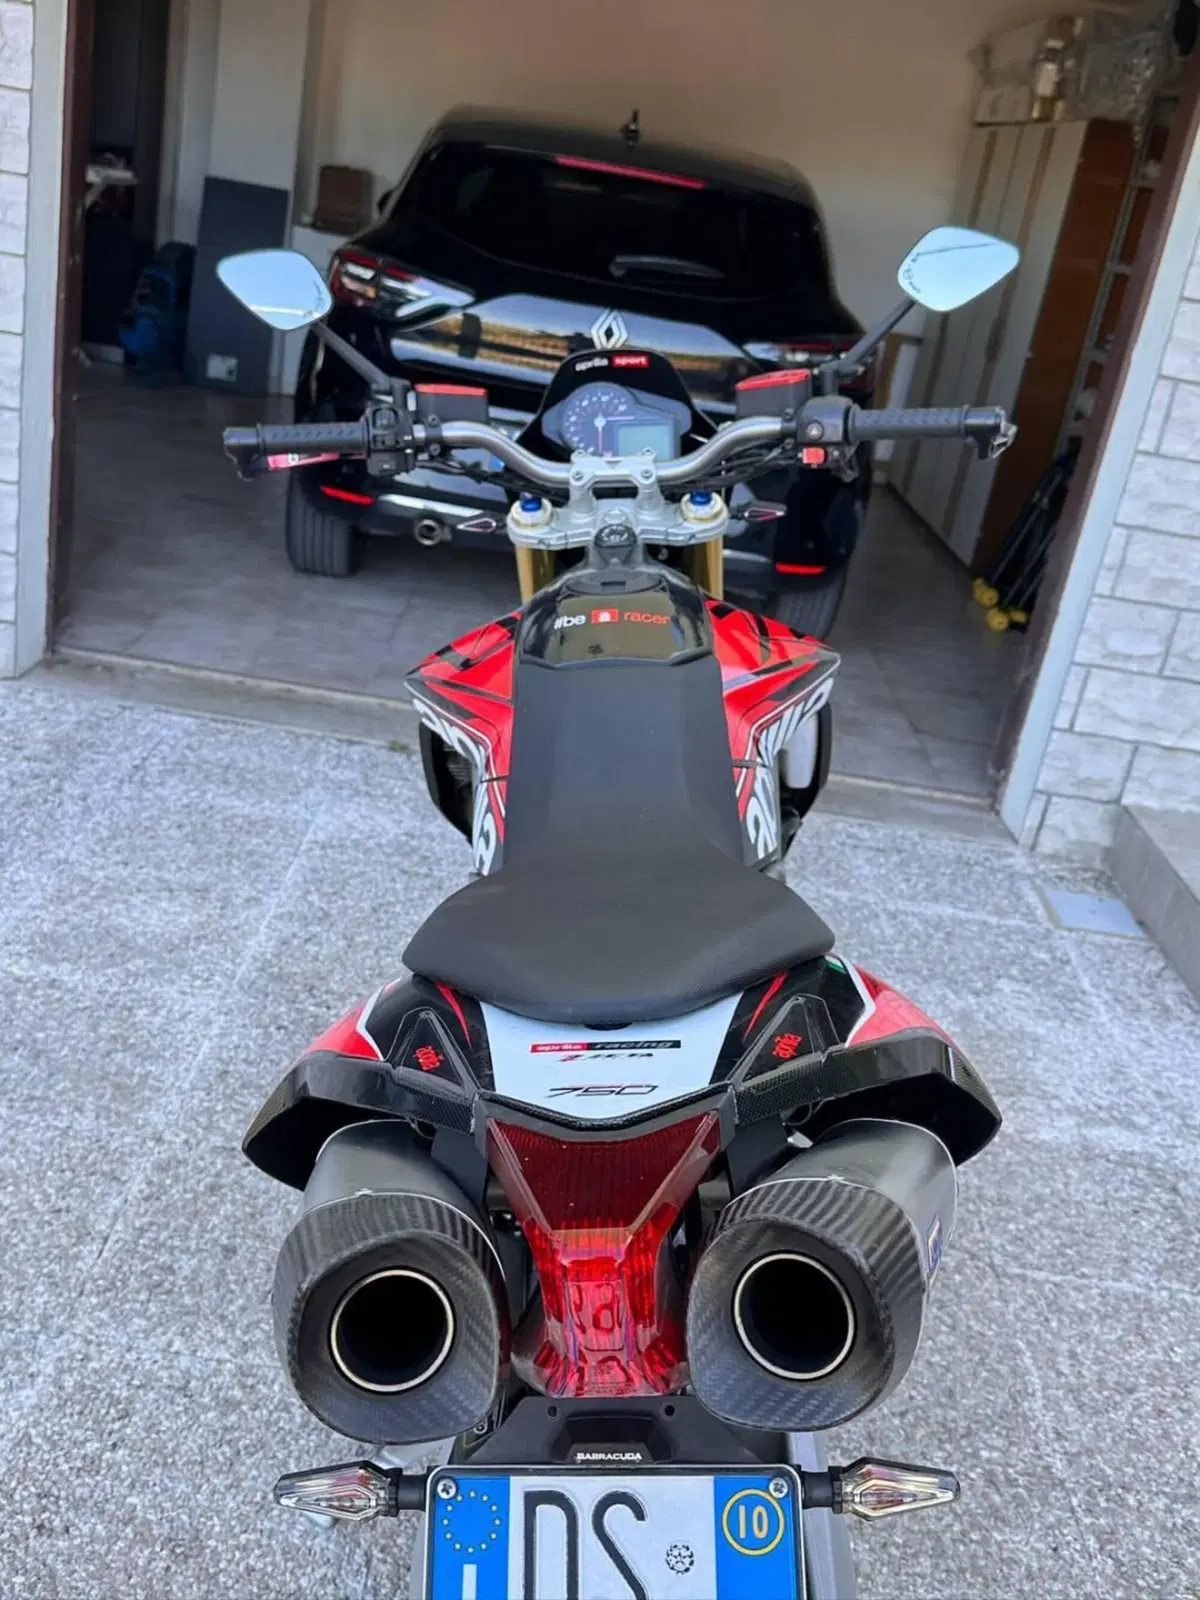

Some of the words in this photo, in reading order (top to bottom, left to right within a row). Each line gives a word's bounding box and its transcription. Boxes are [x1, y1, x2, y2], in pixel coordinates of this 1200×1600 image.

[614, 356, 647, 366] sport
[554, 615, 586, 630] #be
[624, 611, 671, 625] racer
[594, 1040, 675, 1049] racing
[544, 1084, 659, 1098] 750
[576, 1452, 643, 1460] BARRACUDA
[739, 1504, 769, 1539] 10
